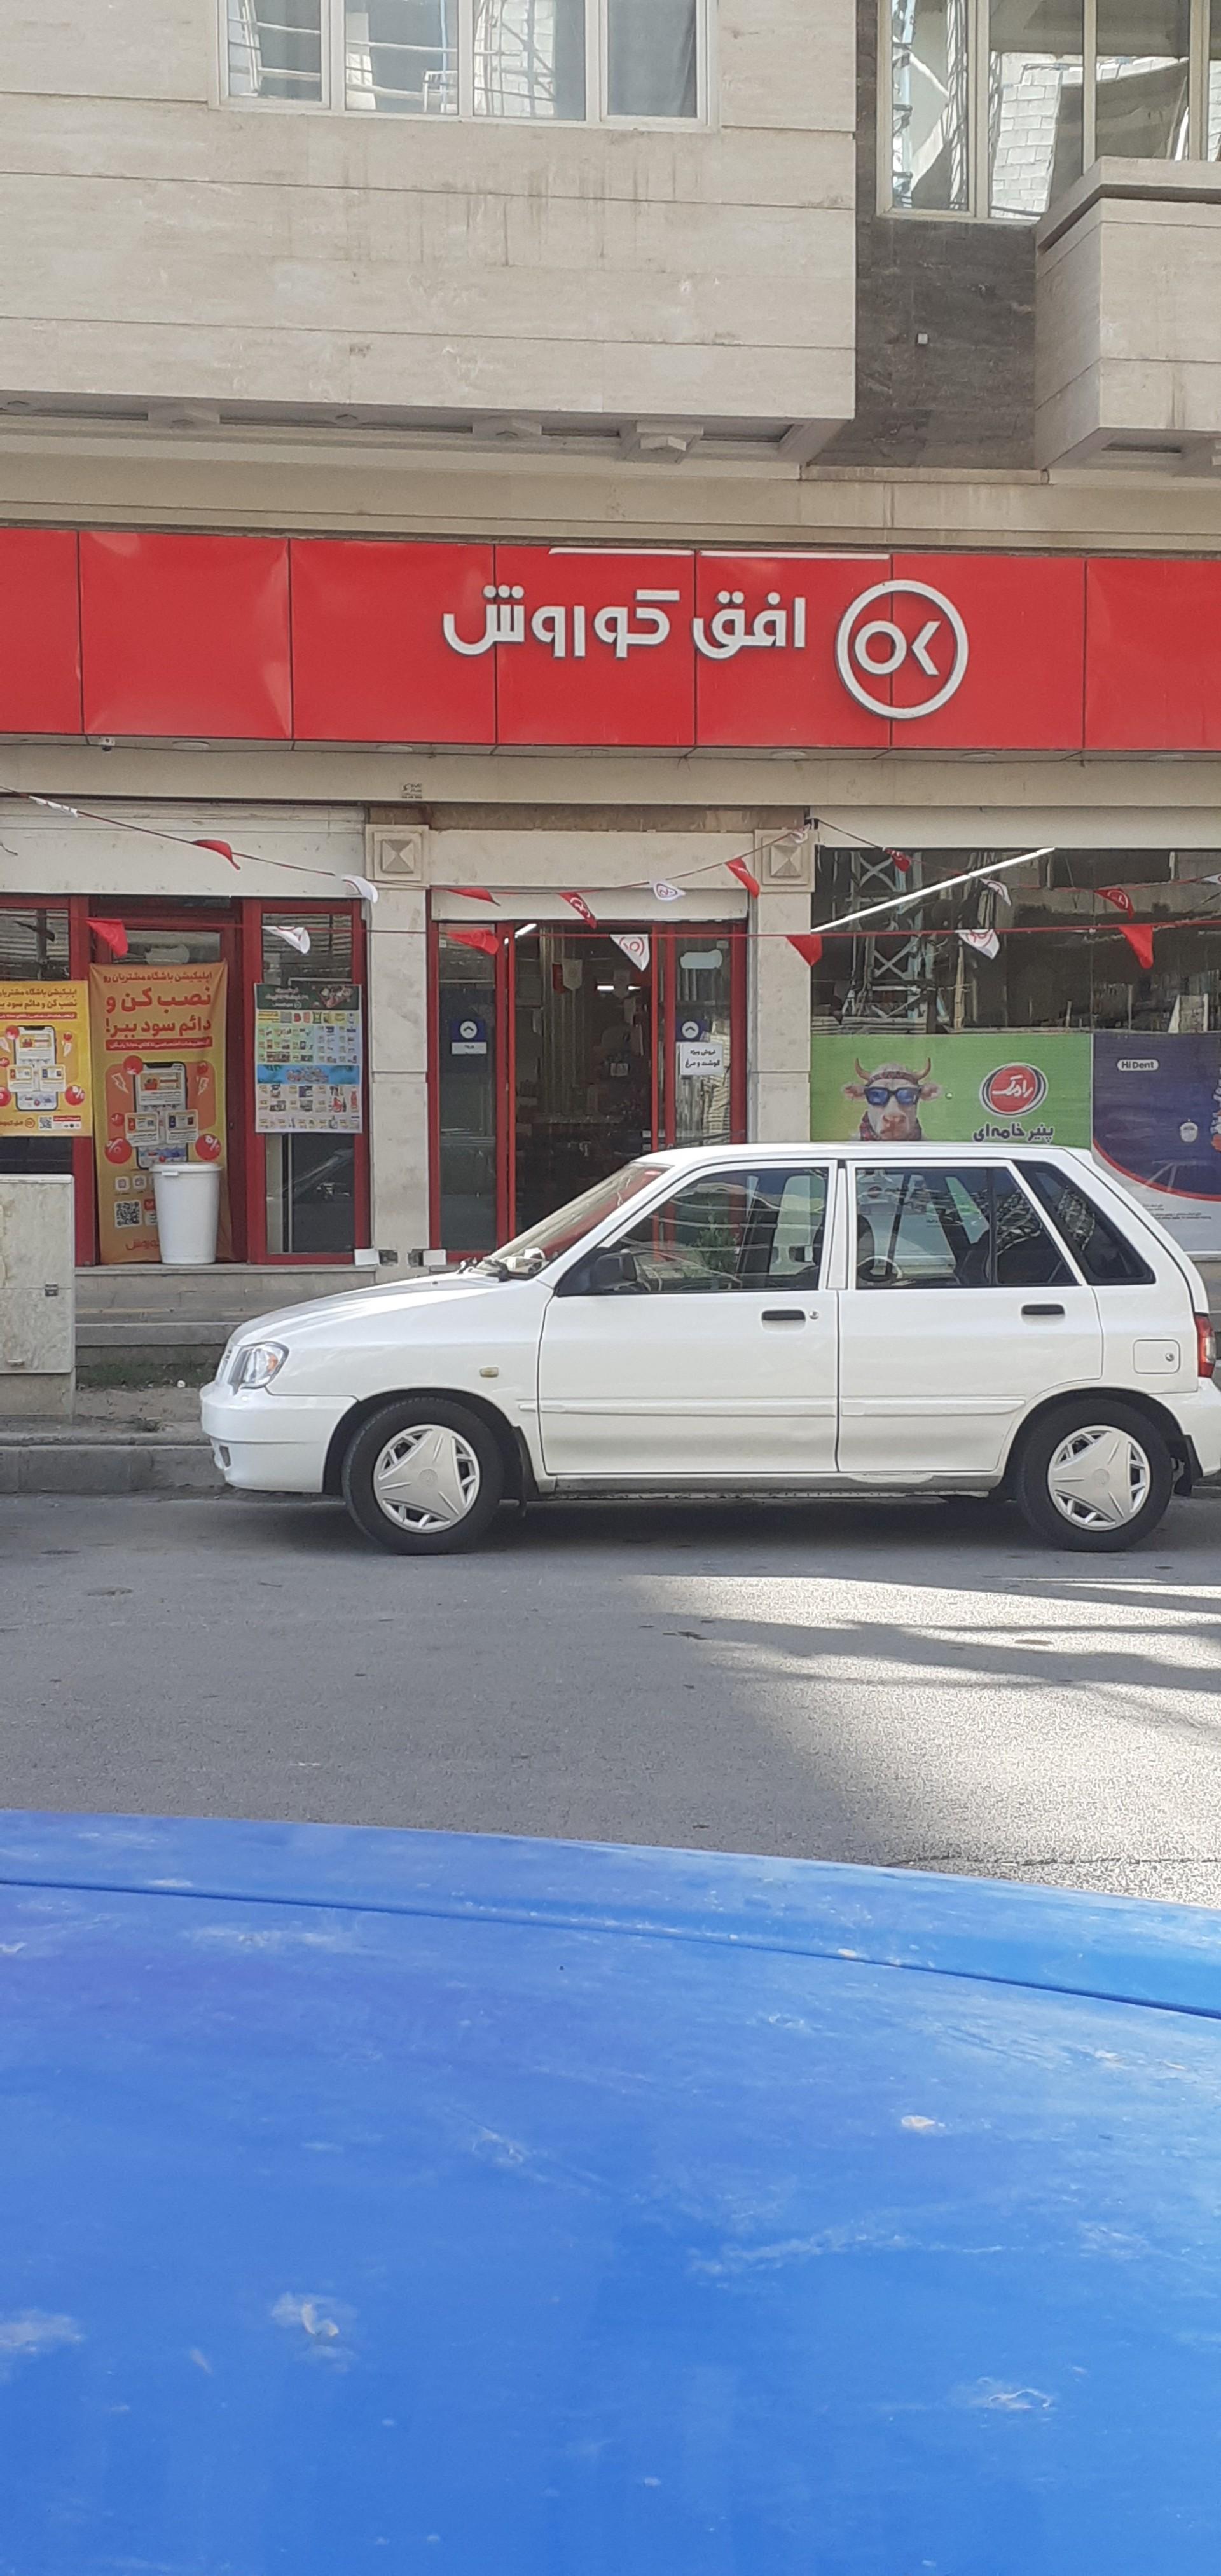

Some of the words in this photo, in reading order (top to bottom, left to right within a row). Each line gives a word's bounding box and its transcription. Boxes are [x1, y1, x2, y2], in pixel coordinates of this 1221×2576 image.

[443, 584, 680, 659] کوروش
[693, 591, 806, 659] افق
[112, 972, 146, 983] مشتریان
[147, 971, 173, 983] باشگاه
[174, 971, 212, 983] اپلیکیشن
[47, 999, 57, 1009] کن
[59, 999, 77, 1010] نصب
[106, 996, 116, 1013] و
[121, 987, 153, 1012] کن
[157, 986, 212, 1013] نصب
[106, 1018, 137, 1038] ببر!
[141, 1020, 176, 1037] سود
[179, 1015, 211, 1036] دائم
[991, 1074, 1033, 1098] رامک
[1028, 1123, 1054, 1142] پنیر
